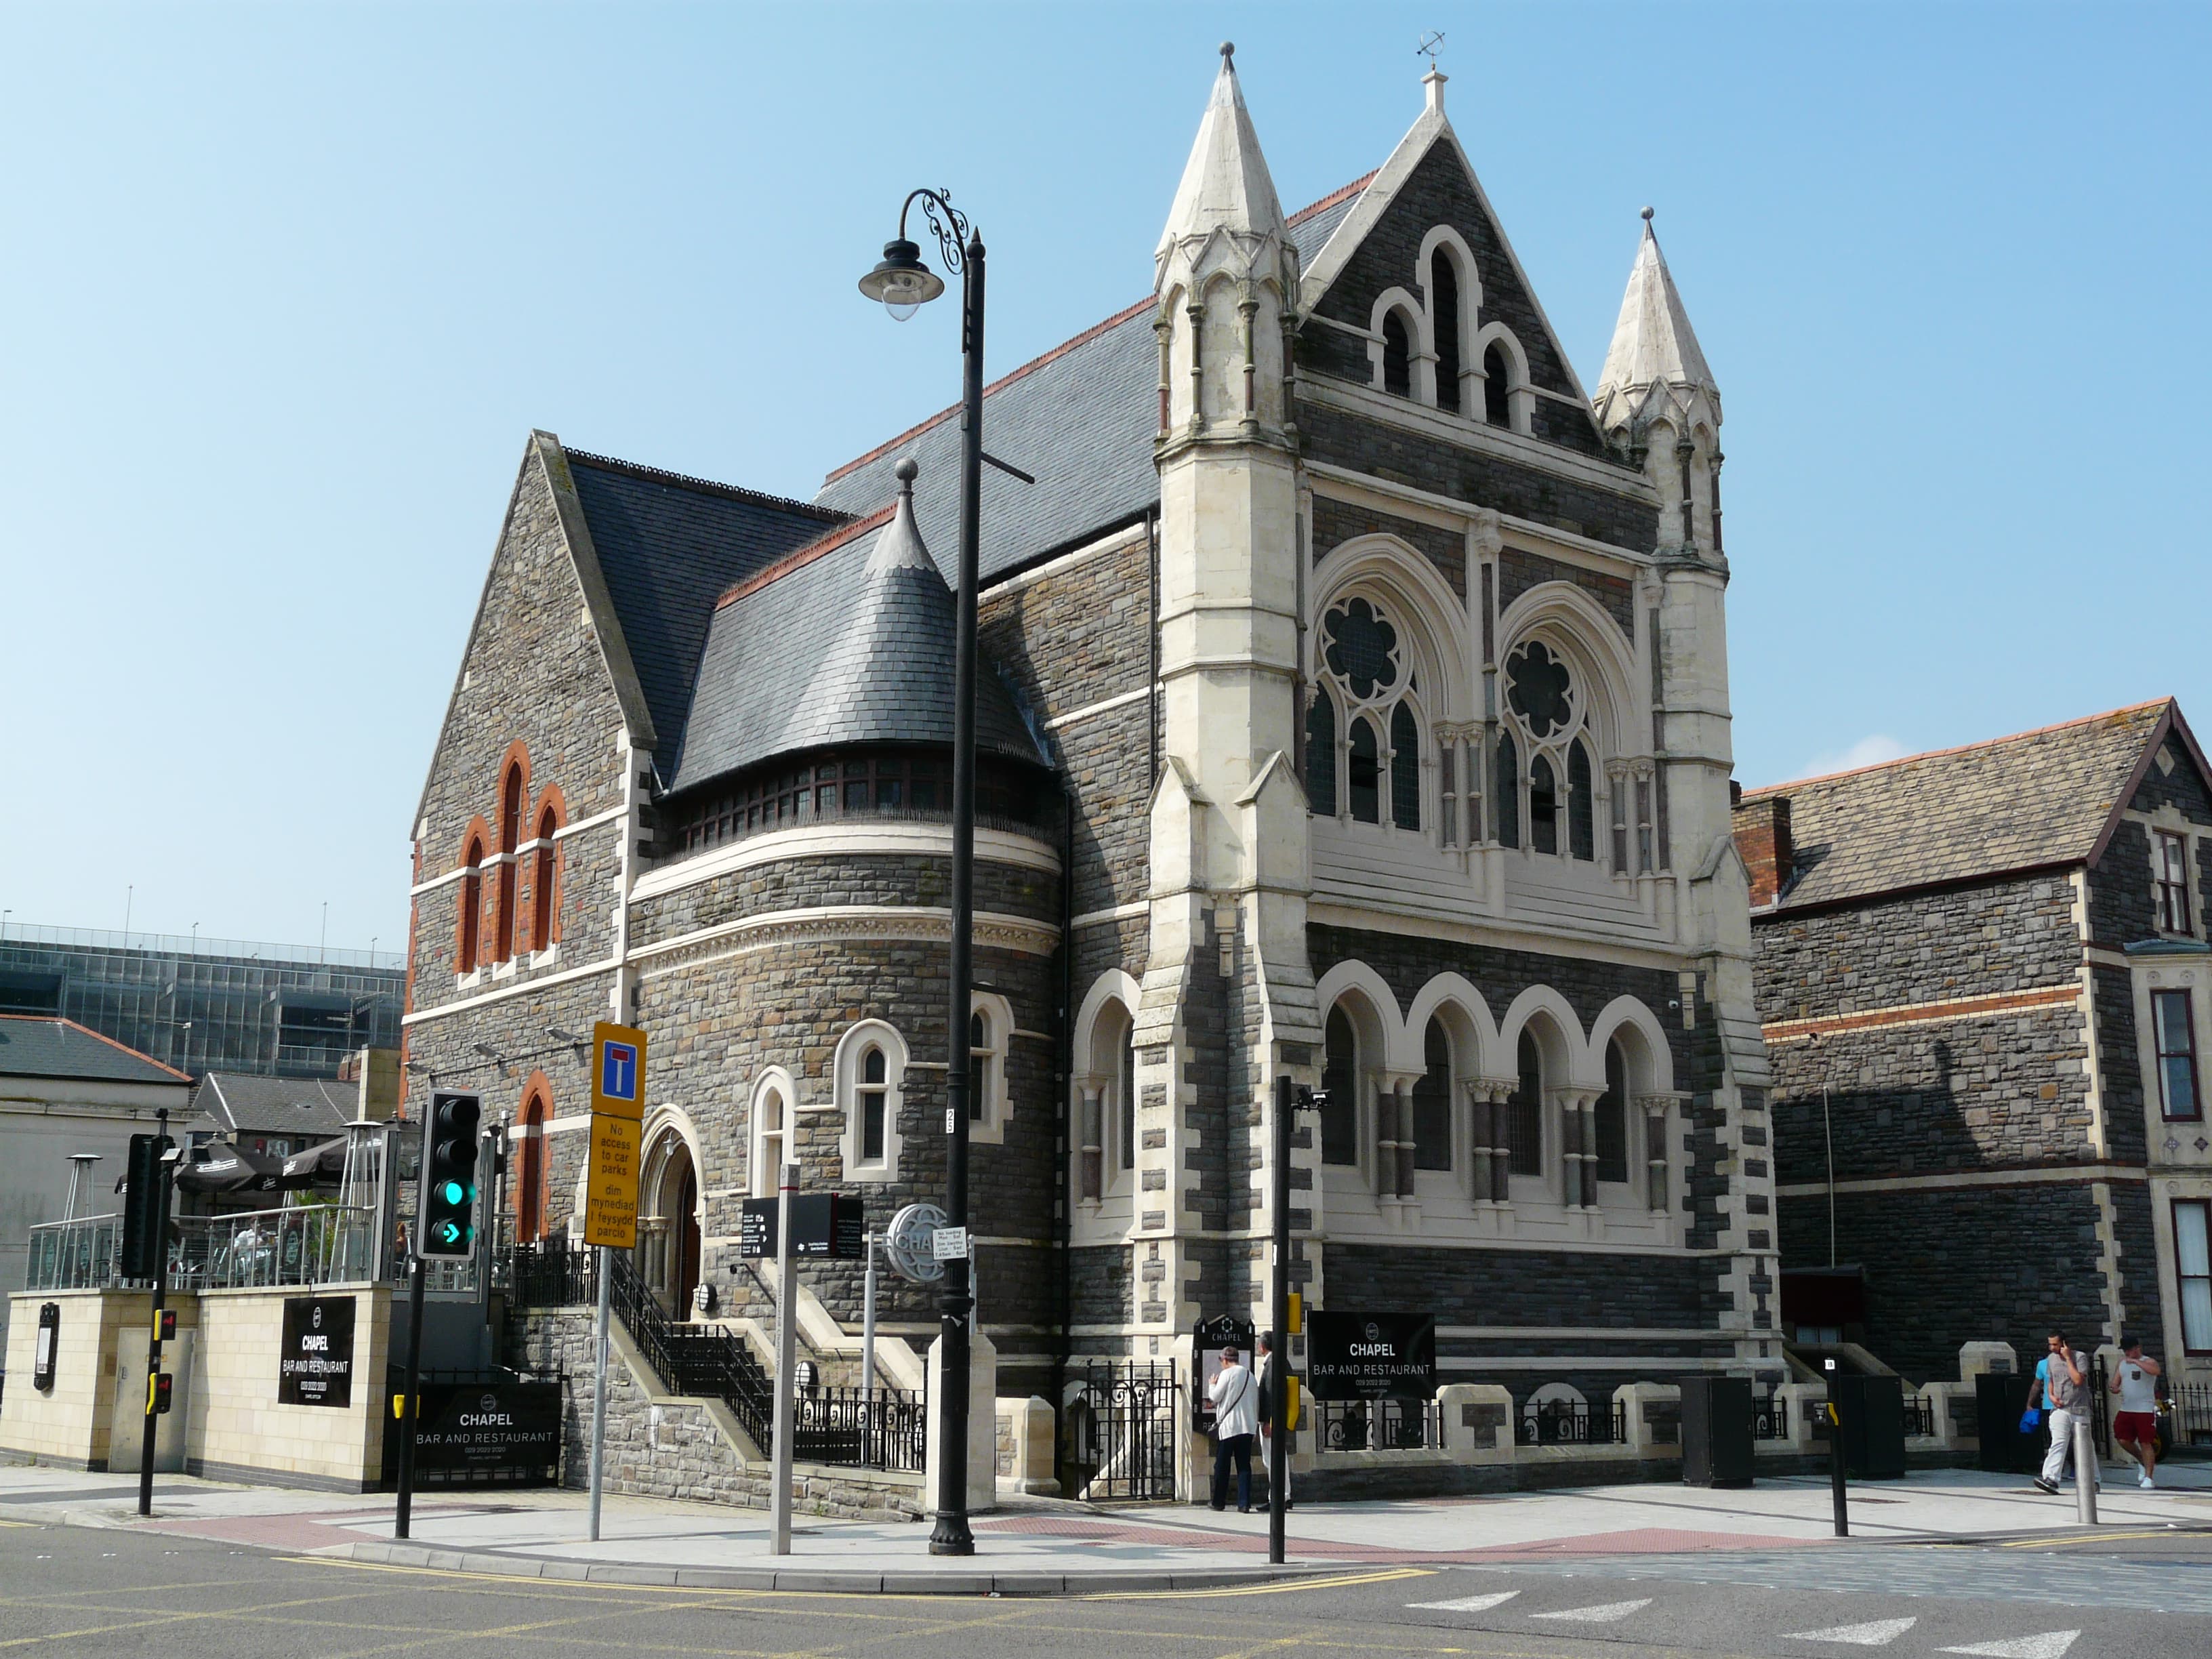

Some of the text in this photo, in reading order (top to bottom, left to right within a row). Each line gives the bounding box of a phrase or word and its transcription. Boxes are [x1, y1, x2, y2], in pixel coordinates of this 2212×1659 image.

[610, 1124, 623, 1136] No
[600, 1138, 631, 1150] access
[602, 1150, 629, 1163] to car
[602, 1164, 628, 1176] parks
[606, 1185, 621, 1196] dim
[591, 1197, 634, 1211] mynediad
[598, 1212, 633, 1227] feysydd
[597, 1227, 626, 1239] parcio
[895, 1233, 933, 1250] CHA
[302, 1335, 328, 1351] CHAPEL
[1212, 1333, 1242, 1342] CHAPEL
[1349, 1343, 1395, 1356] CHAPEL
[283, 1359, 348, 1373] BAR AND RESTAURANT
[1313, 1364, 1431, 1375] BAR AND RESTAURANT
[459, 1414, 513, 1426] CHAPEL
[416, 1432, 553, 1444] BAR AND RESTAURANT
